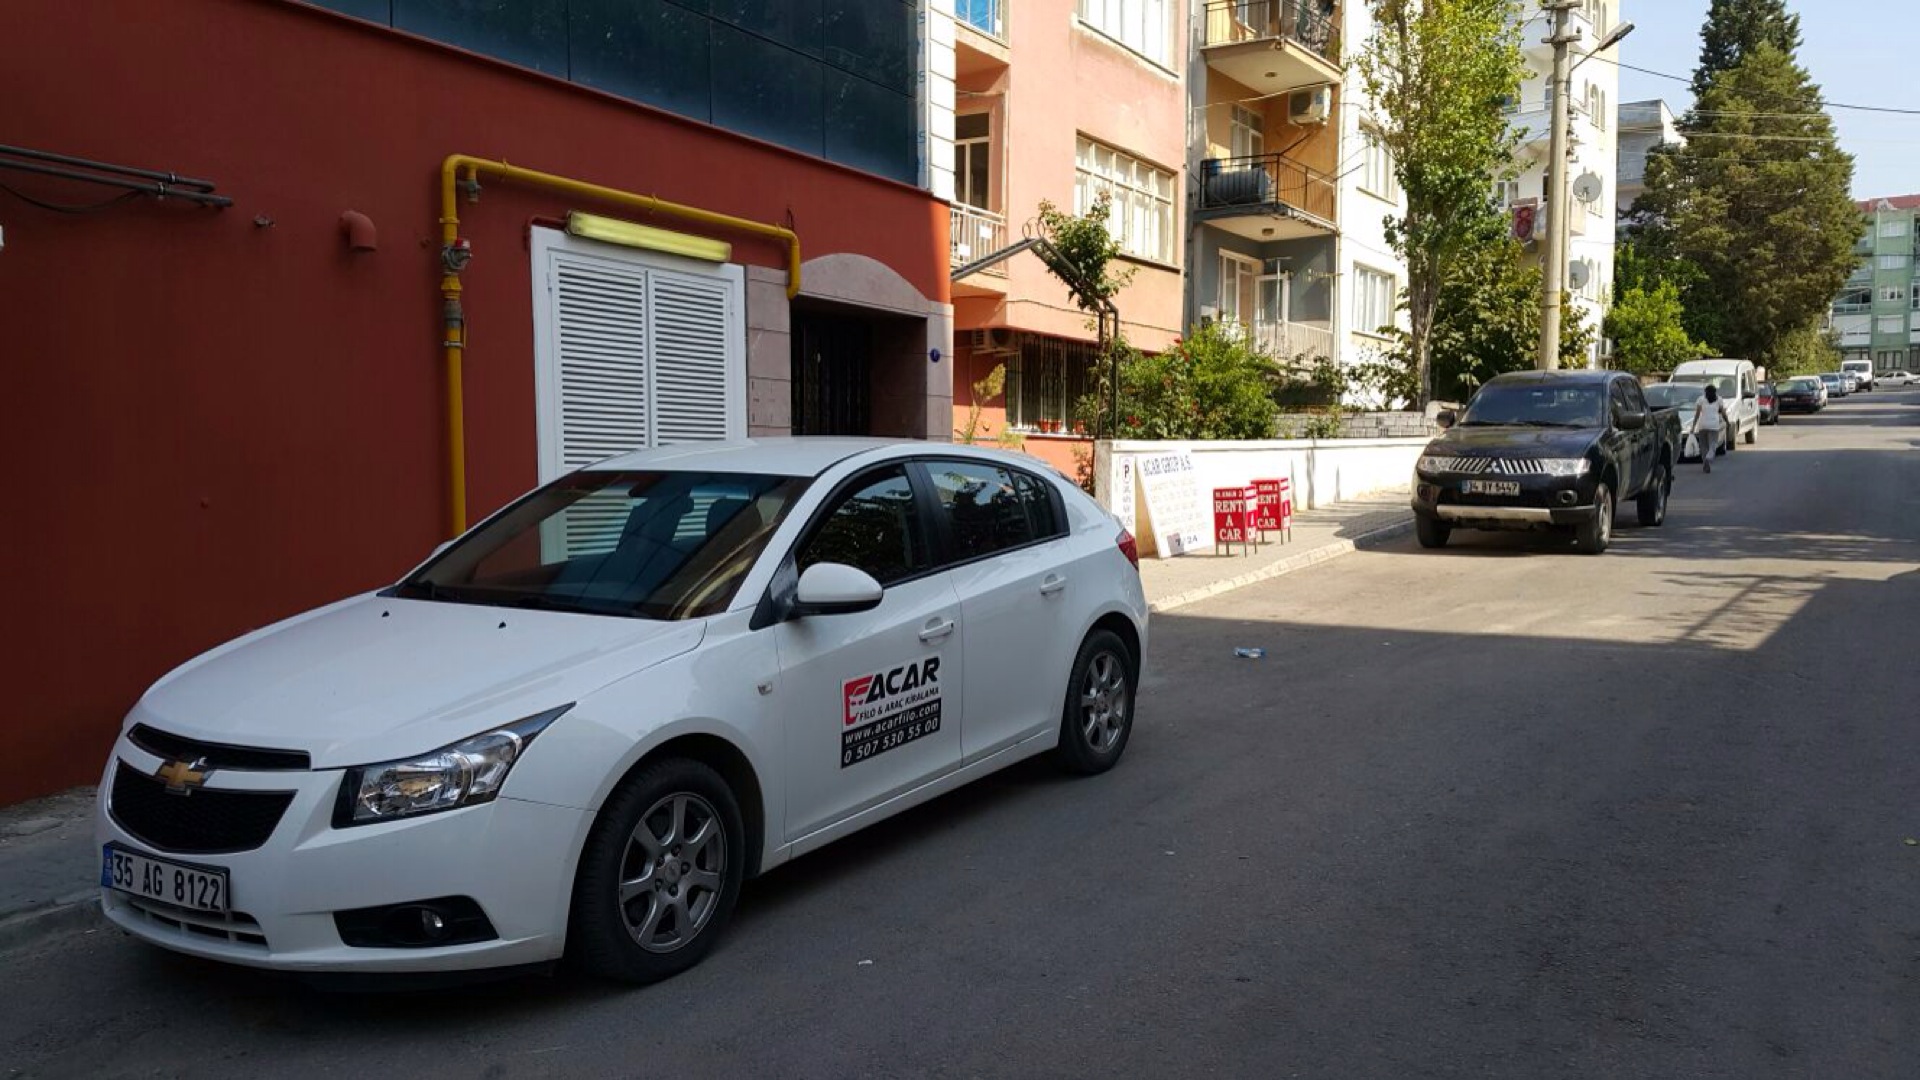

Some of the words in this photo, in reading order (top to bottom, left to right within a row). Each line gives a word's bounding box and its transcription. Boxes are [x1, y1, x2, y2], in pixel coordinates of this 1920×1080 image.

[1216, 501, 1244, 513] RENT
[1263, 506, 1269, 516] A
[1226, 514, 1233, 527] A
[1258, 518, 1277, 528] CAR
[1220, 529, 1242, 540] CAR
[865, 656, 940, 704] ACAR
[845, 702, 939, 744] www.acarfilo.com
[844, 750, 852, 763] 0
[856, 740, 878, 760] 507
[882, 731, 904, 750] 530
[907, 723, 921, 740] 55
[924, 717, 938, 733] 00
[113, 854, 133, 888] 35
[143, 862, 162, 896] AG
[174, 869, 220, 909] 8122
